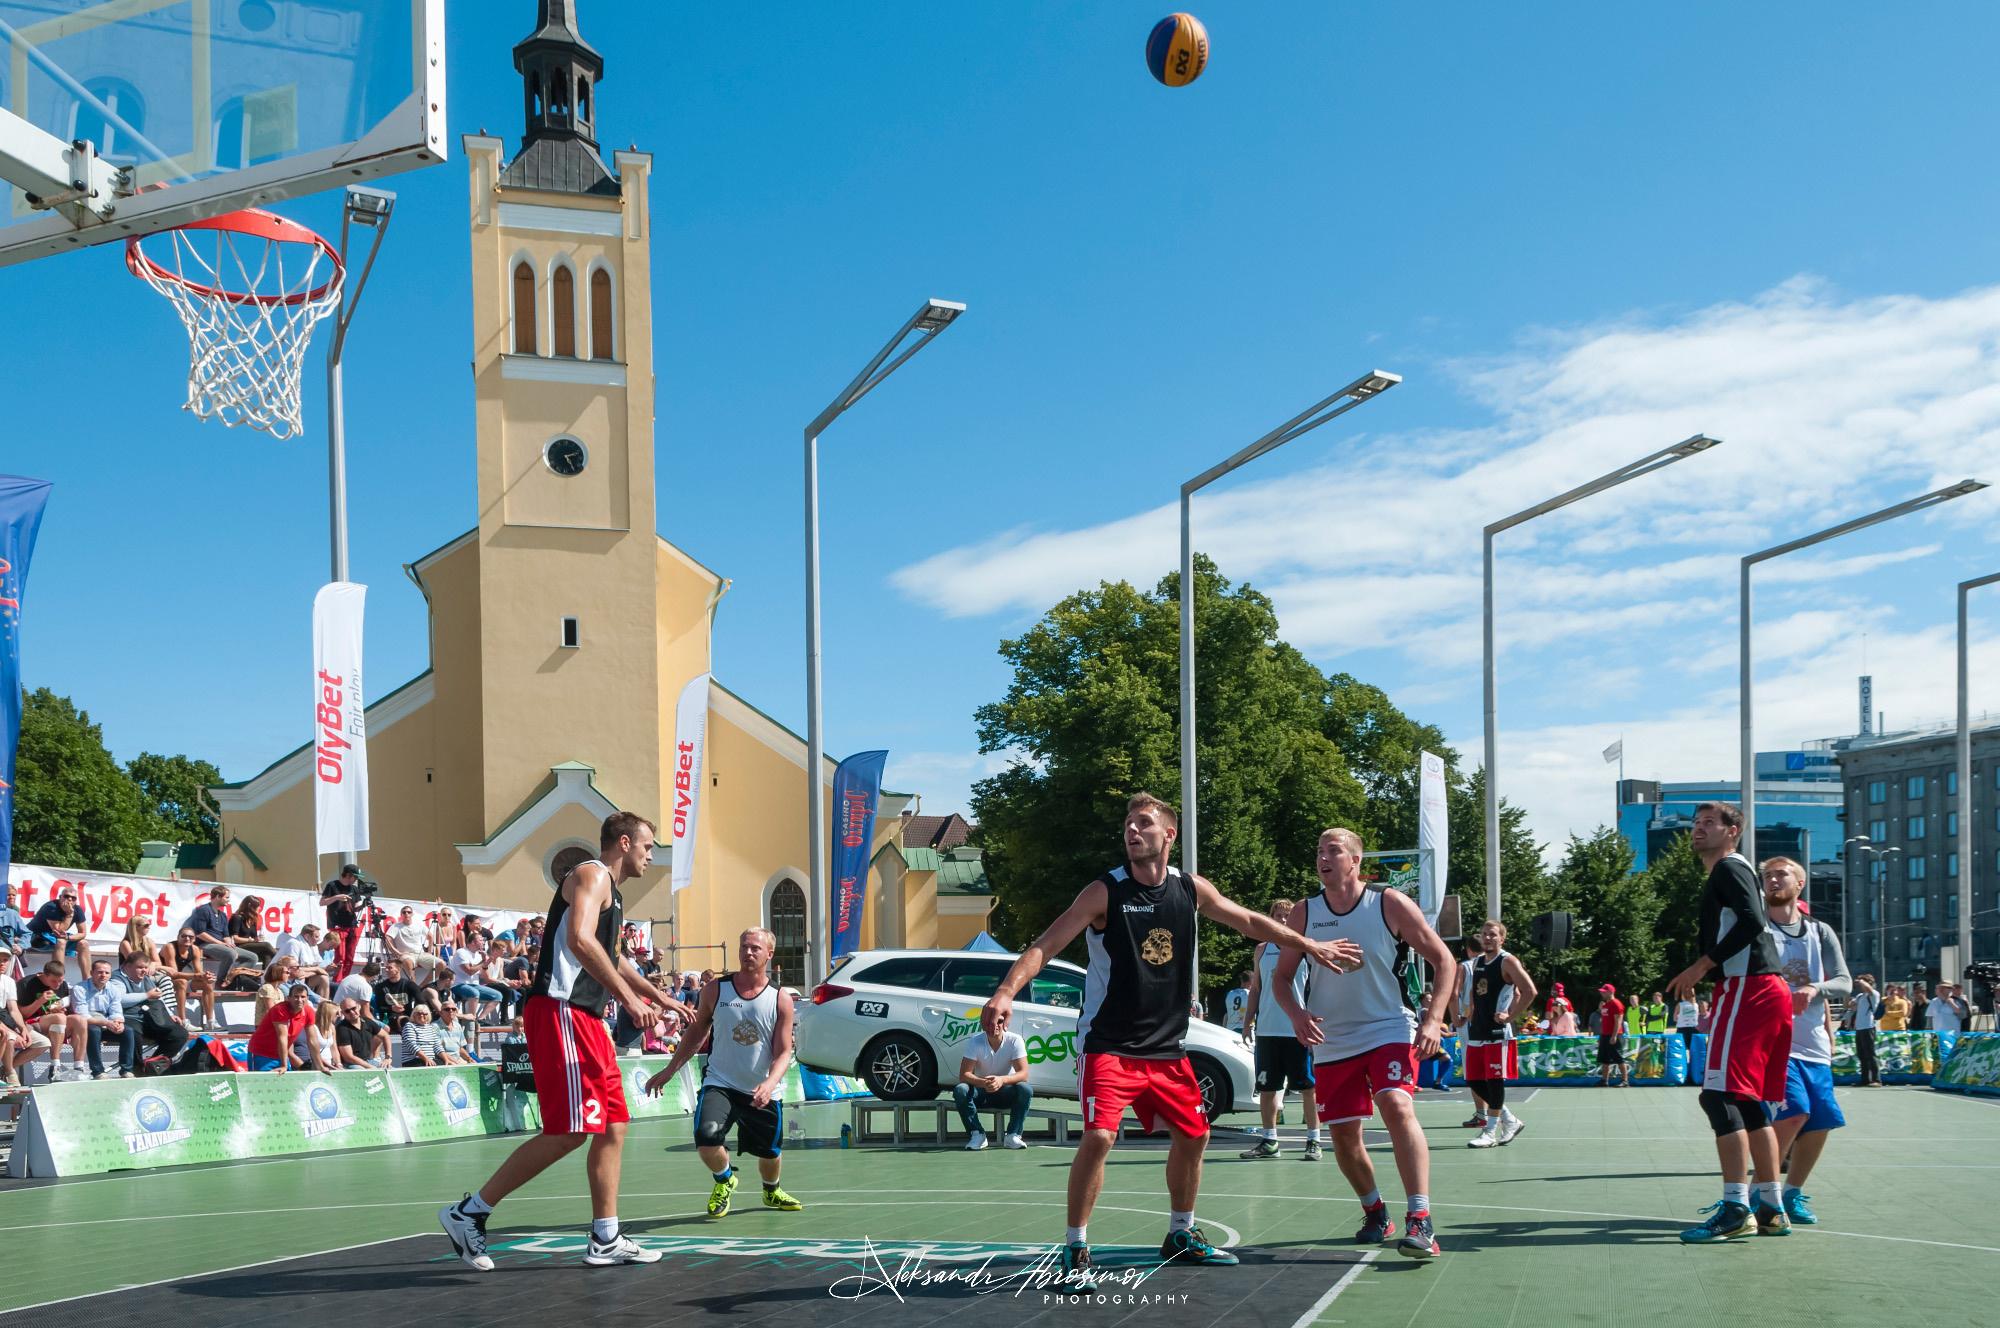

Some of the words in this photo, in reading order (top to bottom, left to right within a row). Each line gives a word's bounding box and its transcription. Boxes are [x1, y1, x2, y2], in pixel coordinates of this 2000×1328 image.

[1862, 677, 1870, 733] HOTELL
[317, 668, 351, 784] OlyBet
[674, 740, 694, 838] OlyBet
[1123, 905, 1154, 913] SPALDING
[1312, 920, 1339, 929] SPALDING
[1233, 996, 1242, 1011] 9
[943, 1020, 983, 1041] Spri
[507, 1062, 534, 1072] SPALDI
[1388, 1061, 1402, 1080] 3
[1257, 1071, 1267, 1086] 4
[586, 1099, 602, 1125] 2
[1086, 1096, 1096, 1122] 1
